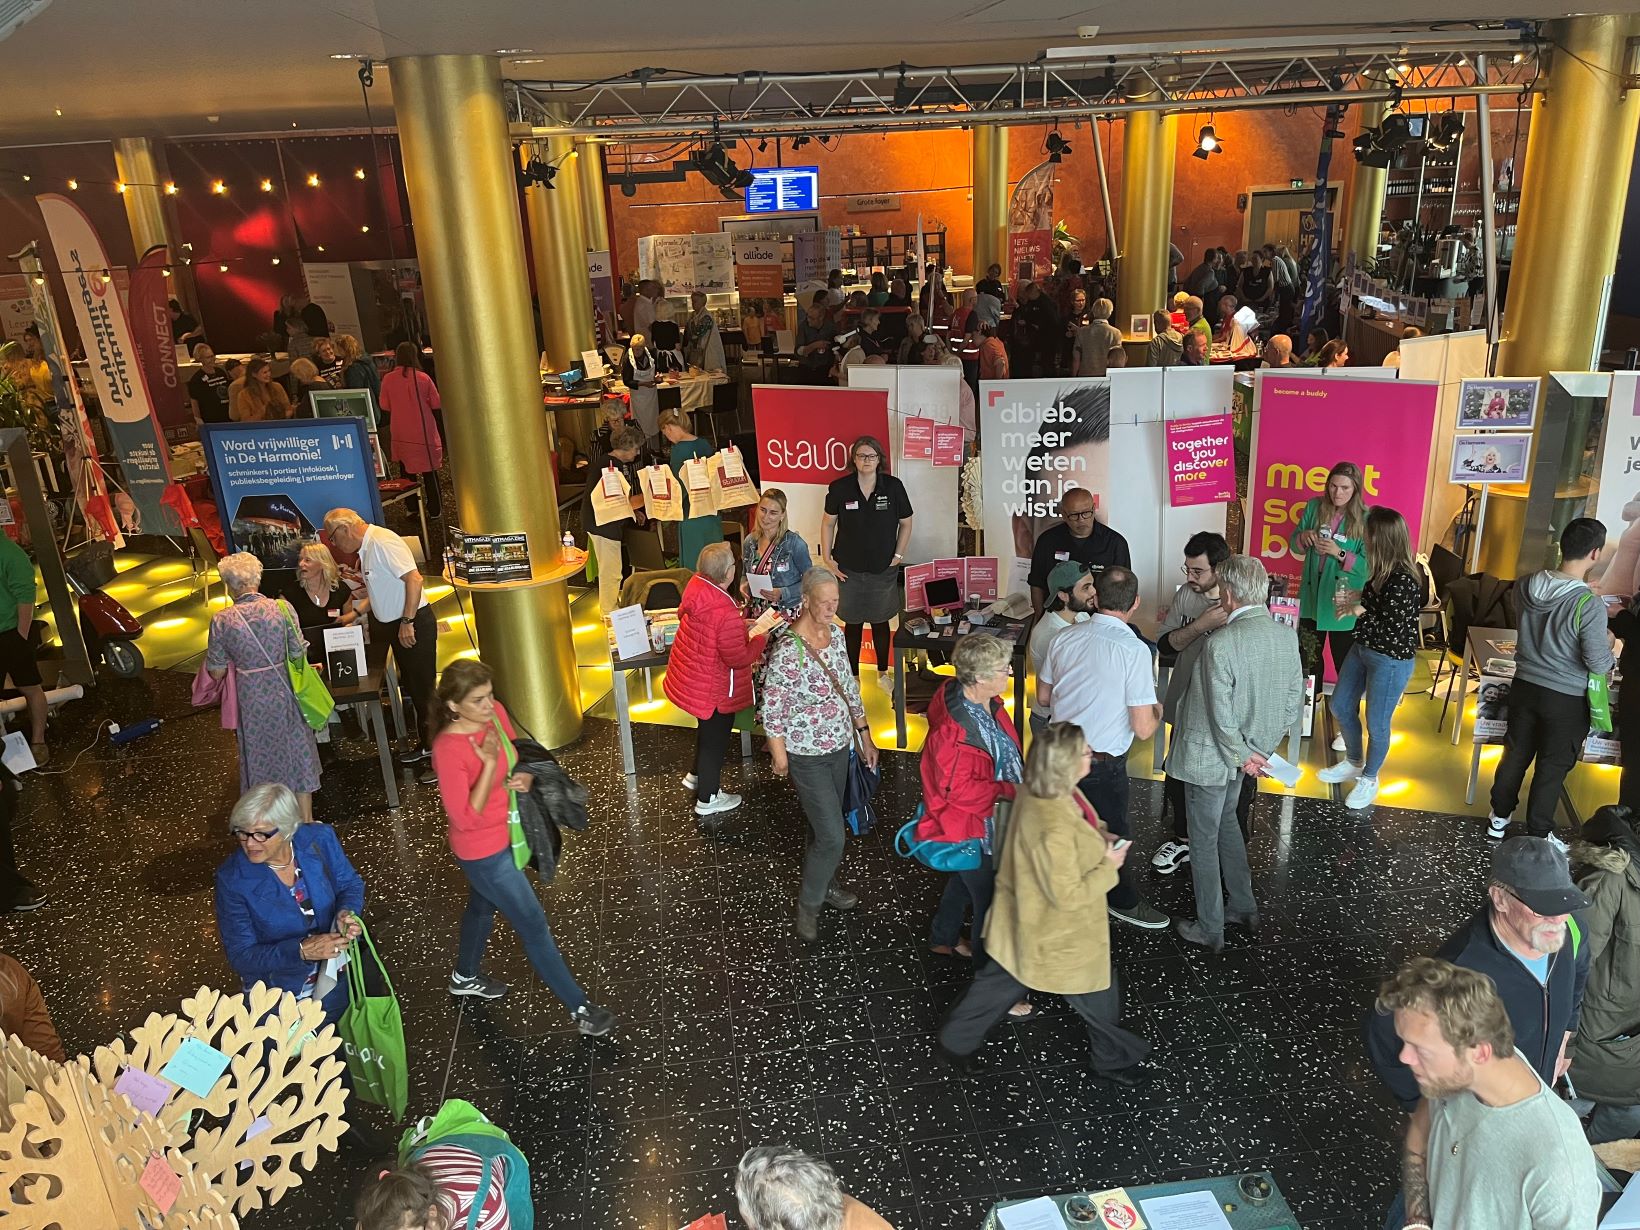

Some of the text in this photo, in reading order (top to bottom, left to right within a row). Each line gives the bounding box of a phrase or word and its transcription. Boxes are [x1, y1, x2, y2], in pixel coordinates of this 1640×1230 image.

[743, 250, 774, 260] alliade
[152, 302, 178, 388] CONNECT
[1274, 388, 1299, 396] become
[1306, 389, 1328, 398] buddy
[1001, 401, 1083, 424] dbieb.
[221, 437, 320, 452] Word vrijwilliger
[1001, 431, 1072, 448] meer
[1172, 435, 1229, 453] together
[224, 448, 322, 465] in De Harmonie!
[1002, 452, 1087, 472] weten
[1191, 448, 1217, 463] you
[228, 468, 269, 478] schminkers
[273, 466, 298, 477] portier
[302, 465, 334, 474] infokiosk
[1173, 458, 1229, 472] discover
[230, 474, 302, 487] publieksbegeleiding
[305, 473, 355, 483] artiestenfoyer
[1001, 474, 1052, 495] dan
[1174, 471, 1207, 482] more
[1266, 462, 1381, 497] met
[1003, 496, 1063, 518] wist.
[1263, 498, 1307, 524] so
[336, 661, 353, 678] 70
